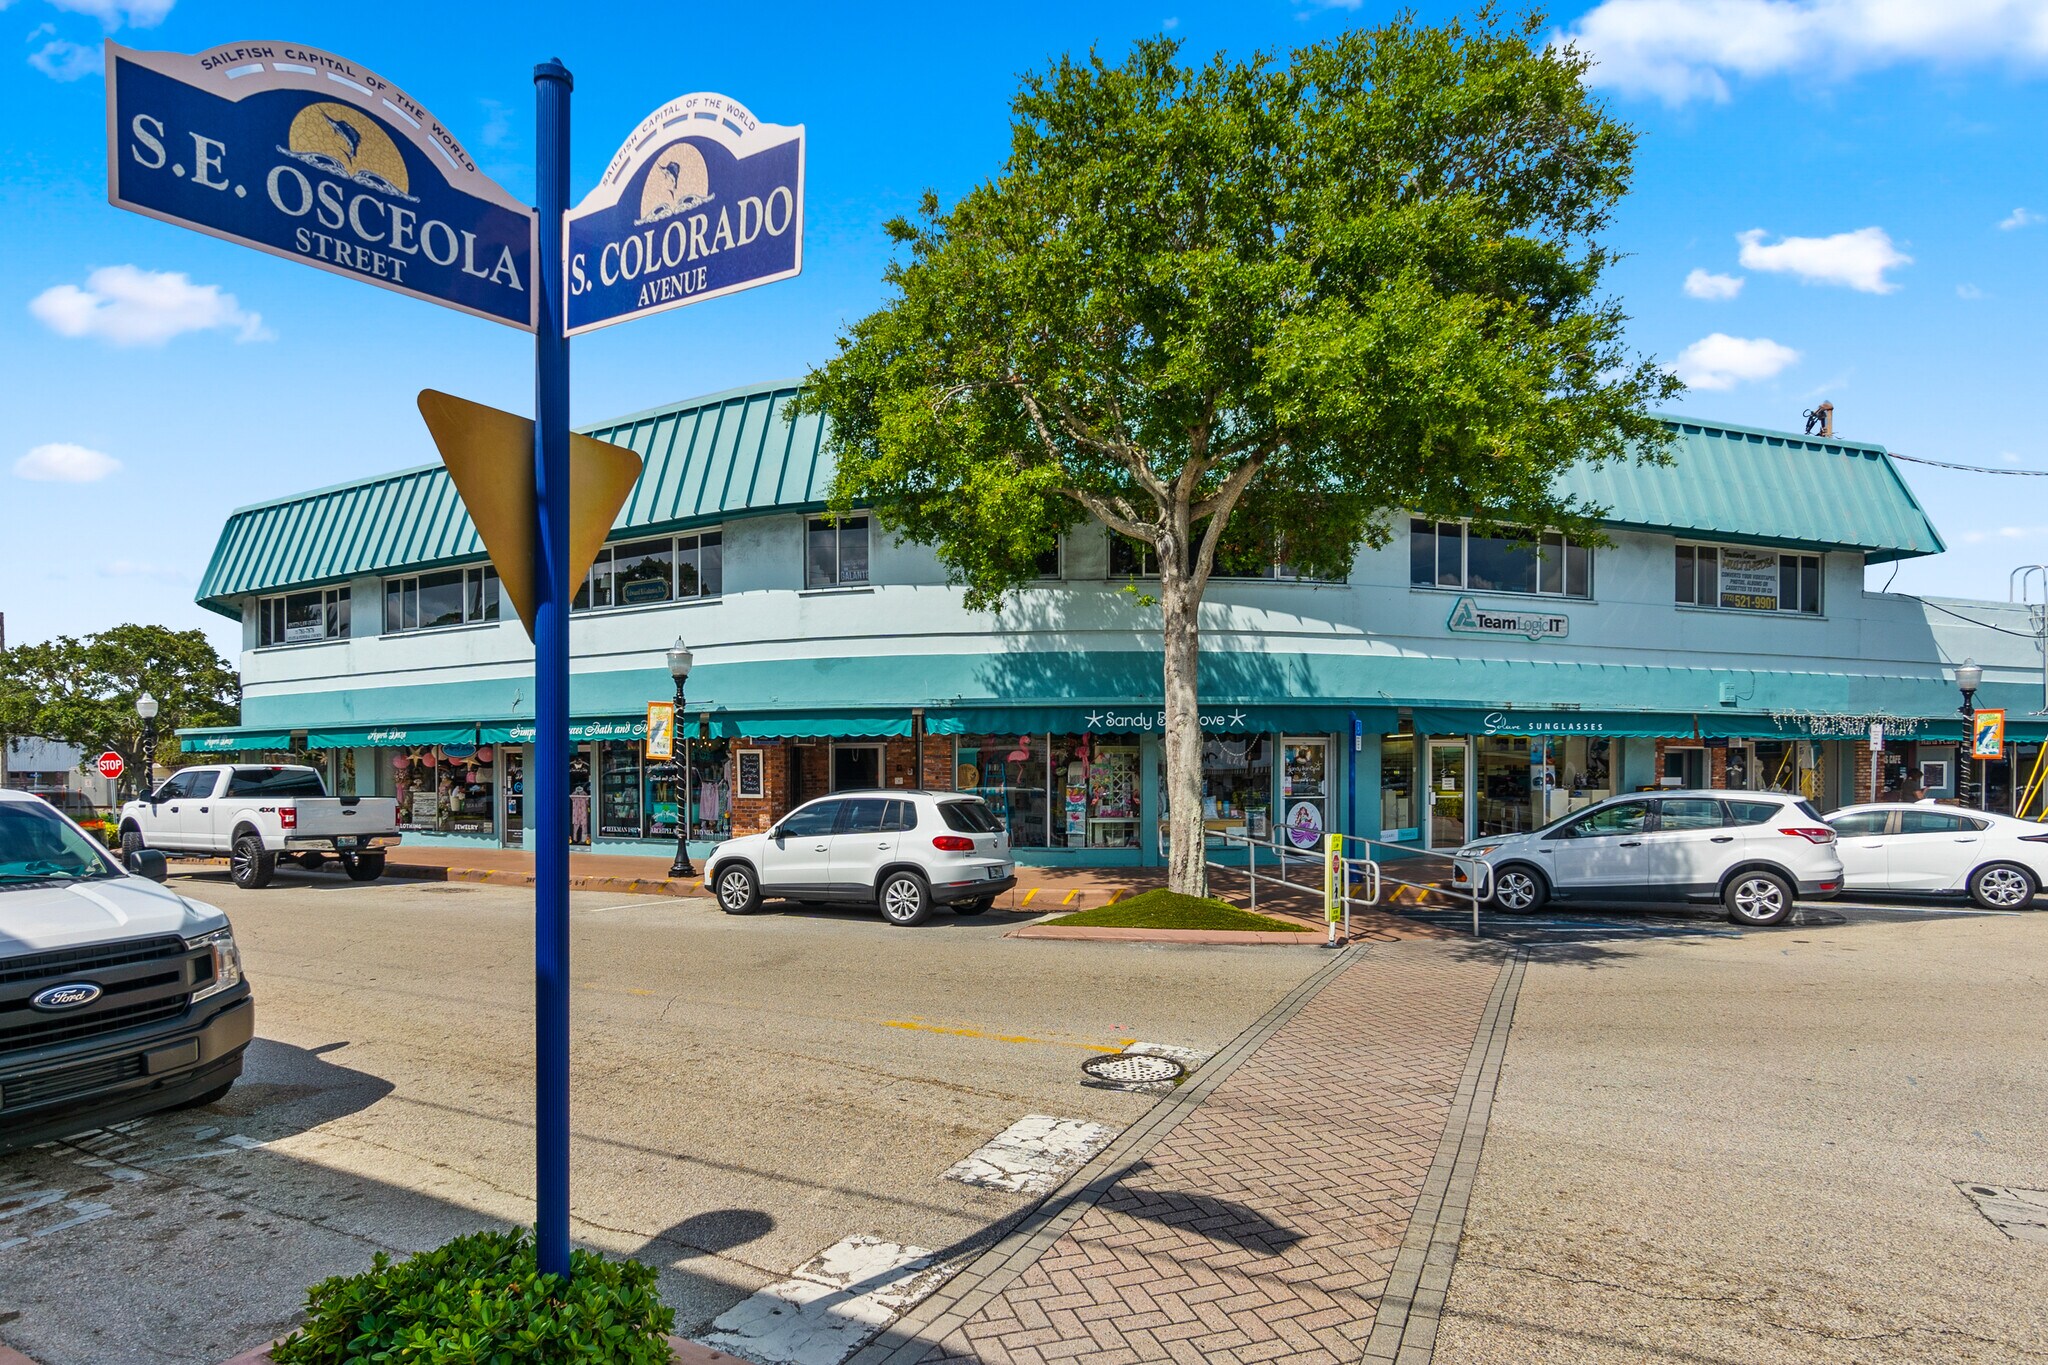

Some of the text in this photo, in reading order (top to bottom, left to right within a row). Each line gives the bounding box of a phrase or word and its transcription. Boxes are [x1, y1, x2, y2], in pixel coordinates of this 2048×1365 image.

[201, 47, 476, 173] SAILFISH CAPITAL OF THE WORLD
[602, 98, 756, 187] SAILFISH CAPITAL OF THE WORLD
[131, 113, 524, 292] S.E. OSCEOLA
[571, 186, 793, 296] S. COLORADO
[295, 228, 407, 283] STREET
[637, 266, 708, 307] AVENUE
[1734, 595, 1776, 609] 521-9901
[584, 721, 613, 737] Bath
[614, 720, 630, 733] and
[1105, 711, 1152, 731] Sandy
[1199, 714, 1225, 727] ove
[1528, 722, 1603, 731] SUNGLASSES
[100, 759, 122, 771] STOP
[454, 823, 479, 831] JEWELRY
[51, 989, 86, 1004] Ford
